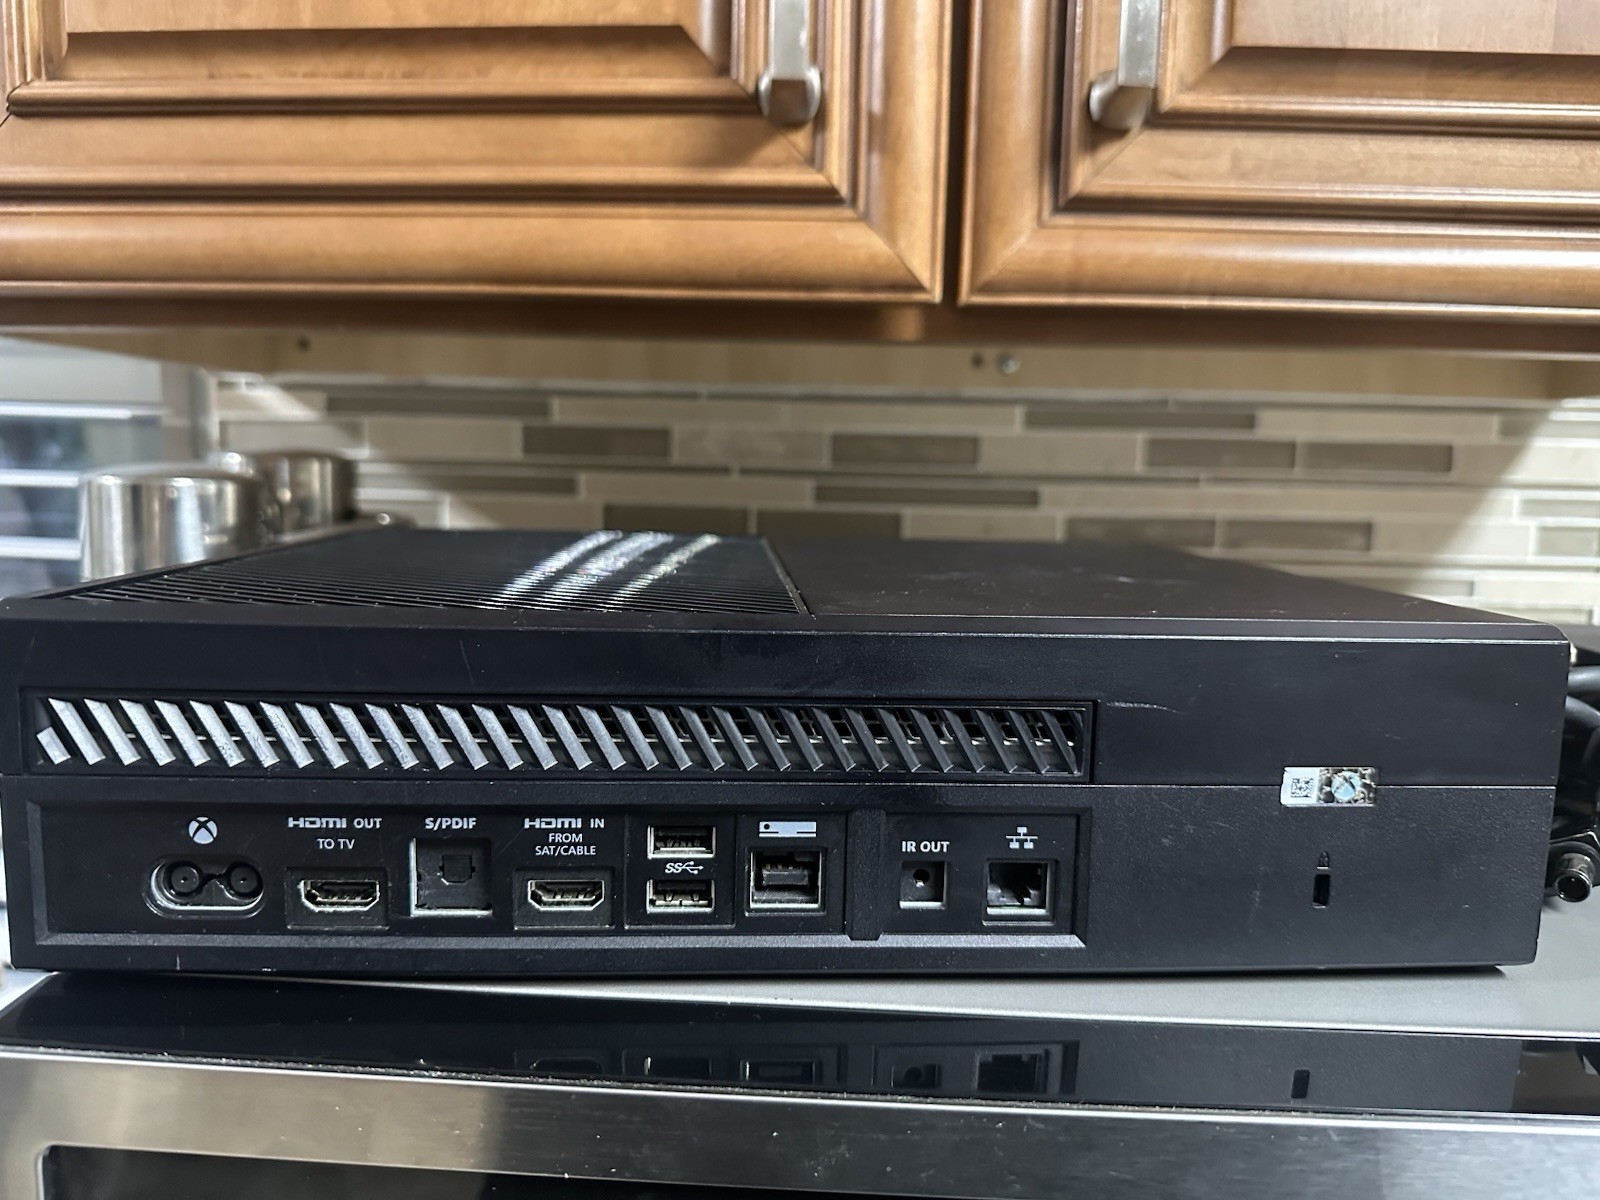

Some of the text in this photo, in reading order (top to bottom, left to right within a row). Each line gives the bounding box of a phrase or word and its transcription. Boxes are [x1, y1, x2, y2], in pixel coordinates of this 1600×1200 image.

[354, 817, 383, 829] OUT
[425, 817, 477, 831] S/PDIF
[590, 817, 605, 829] IN
[317, 838, 355, 850] TO TV
[548, 833, 584, 843] FROM
[535, 845, 597, 857] SAT/CABLE
[901, 840, 950, 853] IR OUT
